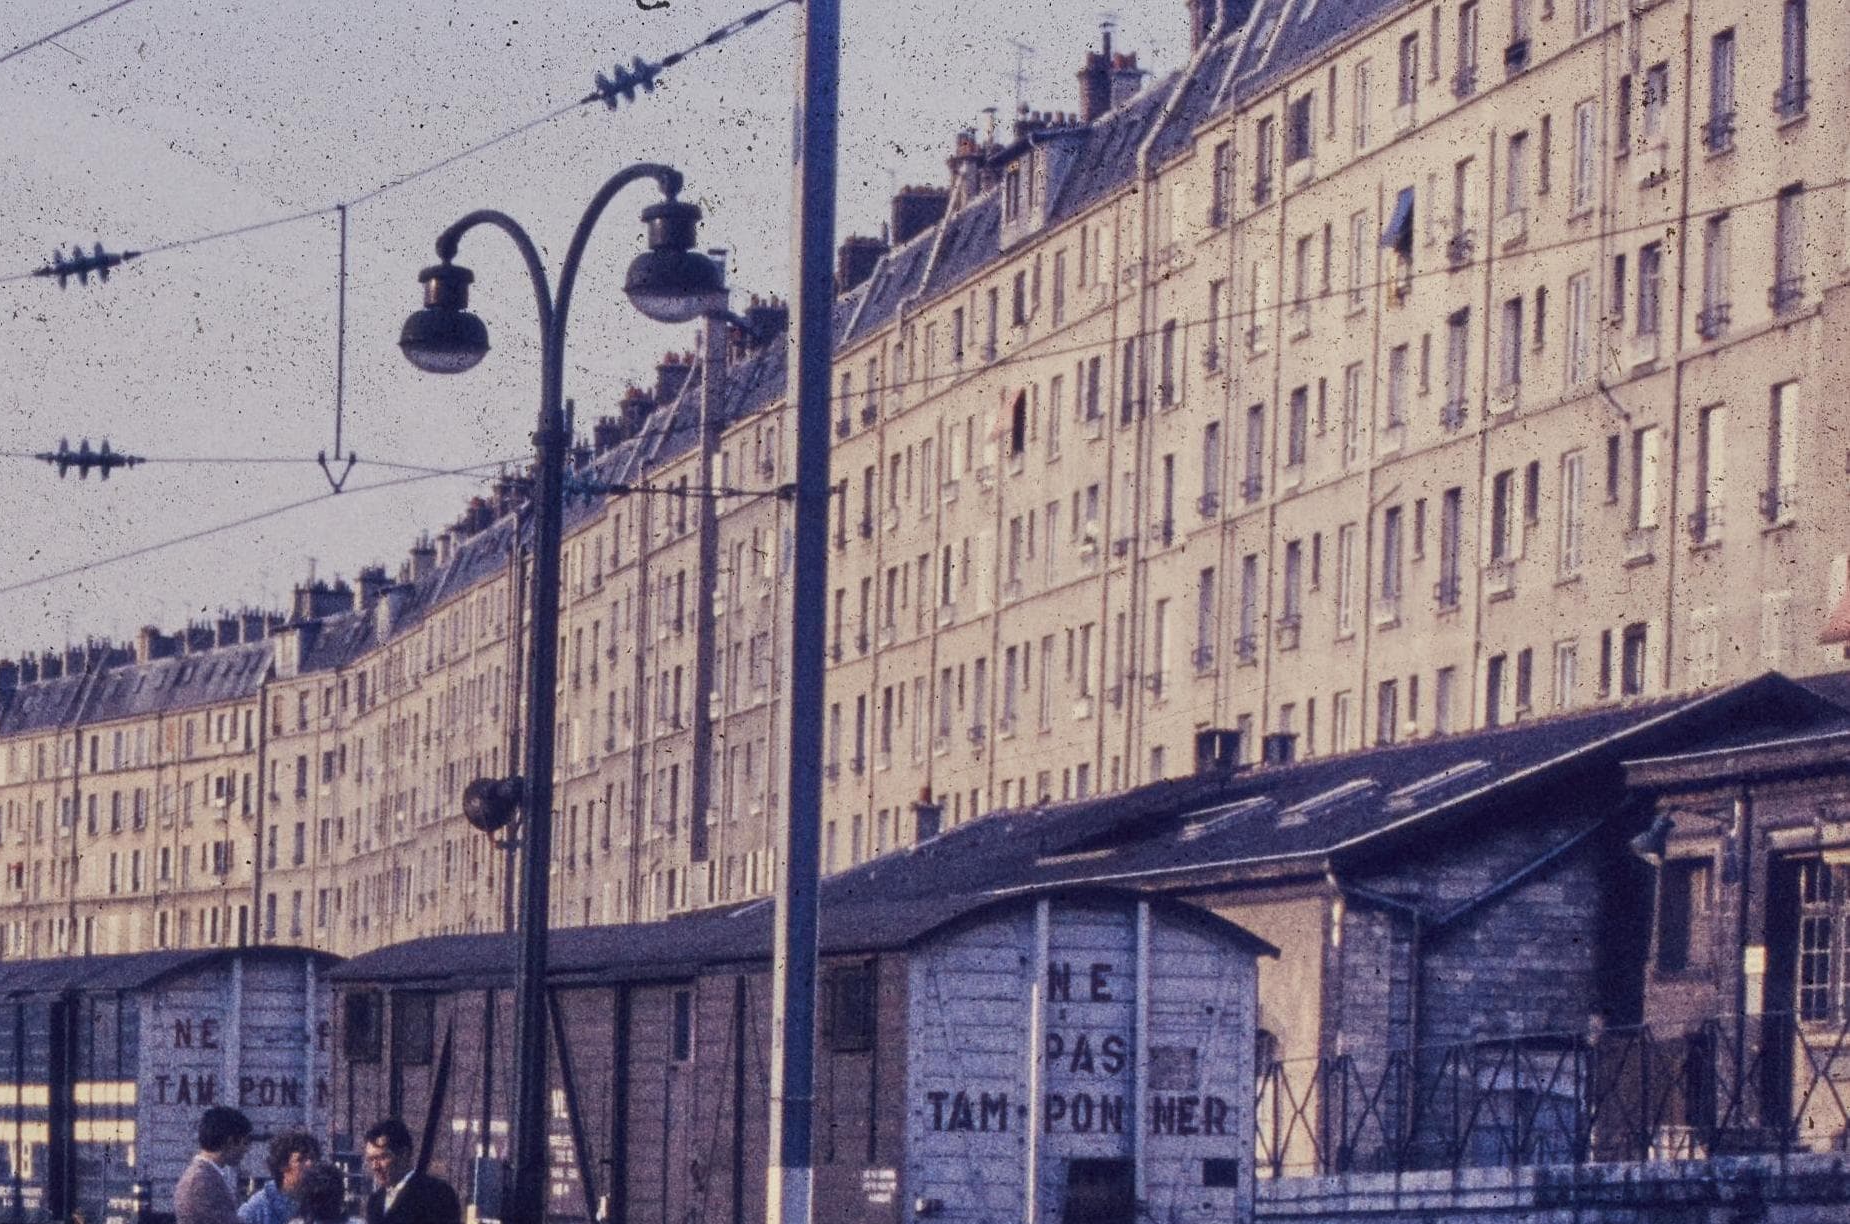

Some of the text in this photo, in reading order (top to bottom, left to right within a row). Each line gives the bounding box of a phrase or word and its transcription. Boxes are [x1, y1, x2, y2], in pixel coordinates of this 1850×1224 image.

[1047, 962, 1113, 1002] NE
[174, 1018, 219, 1049] NE
[1045, 1032, 1127, 1075] PAS
